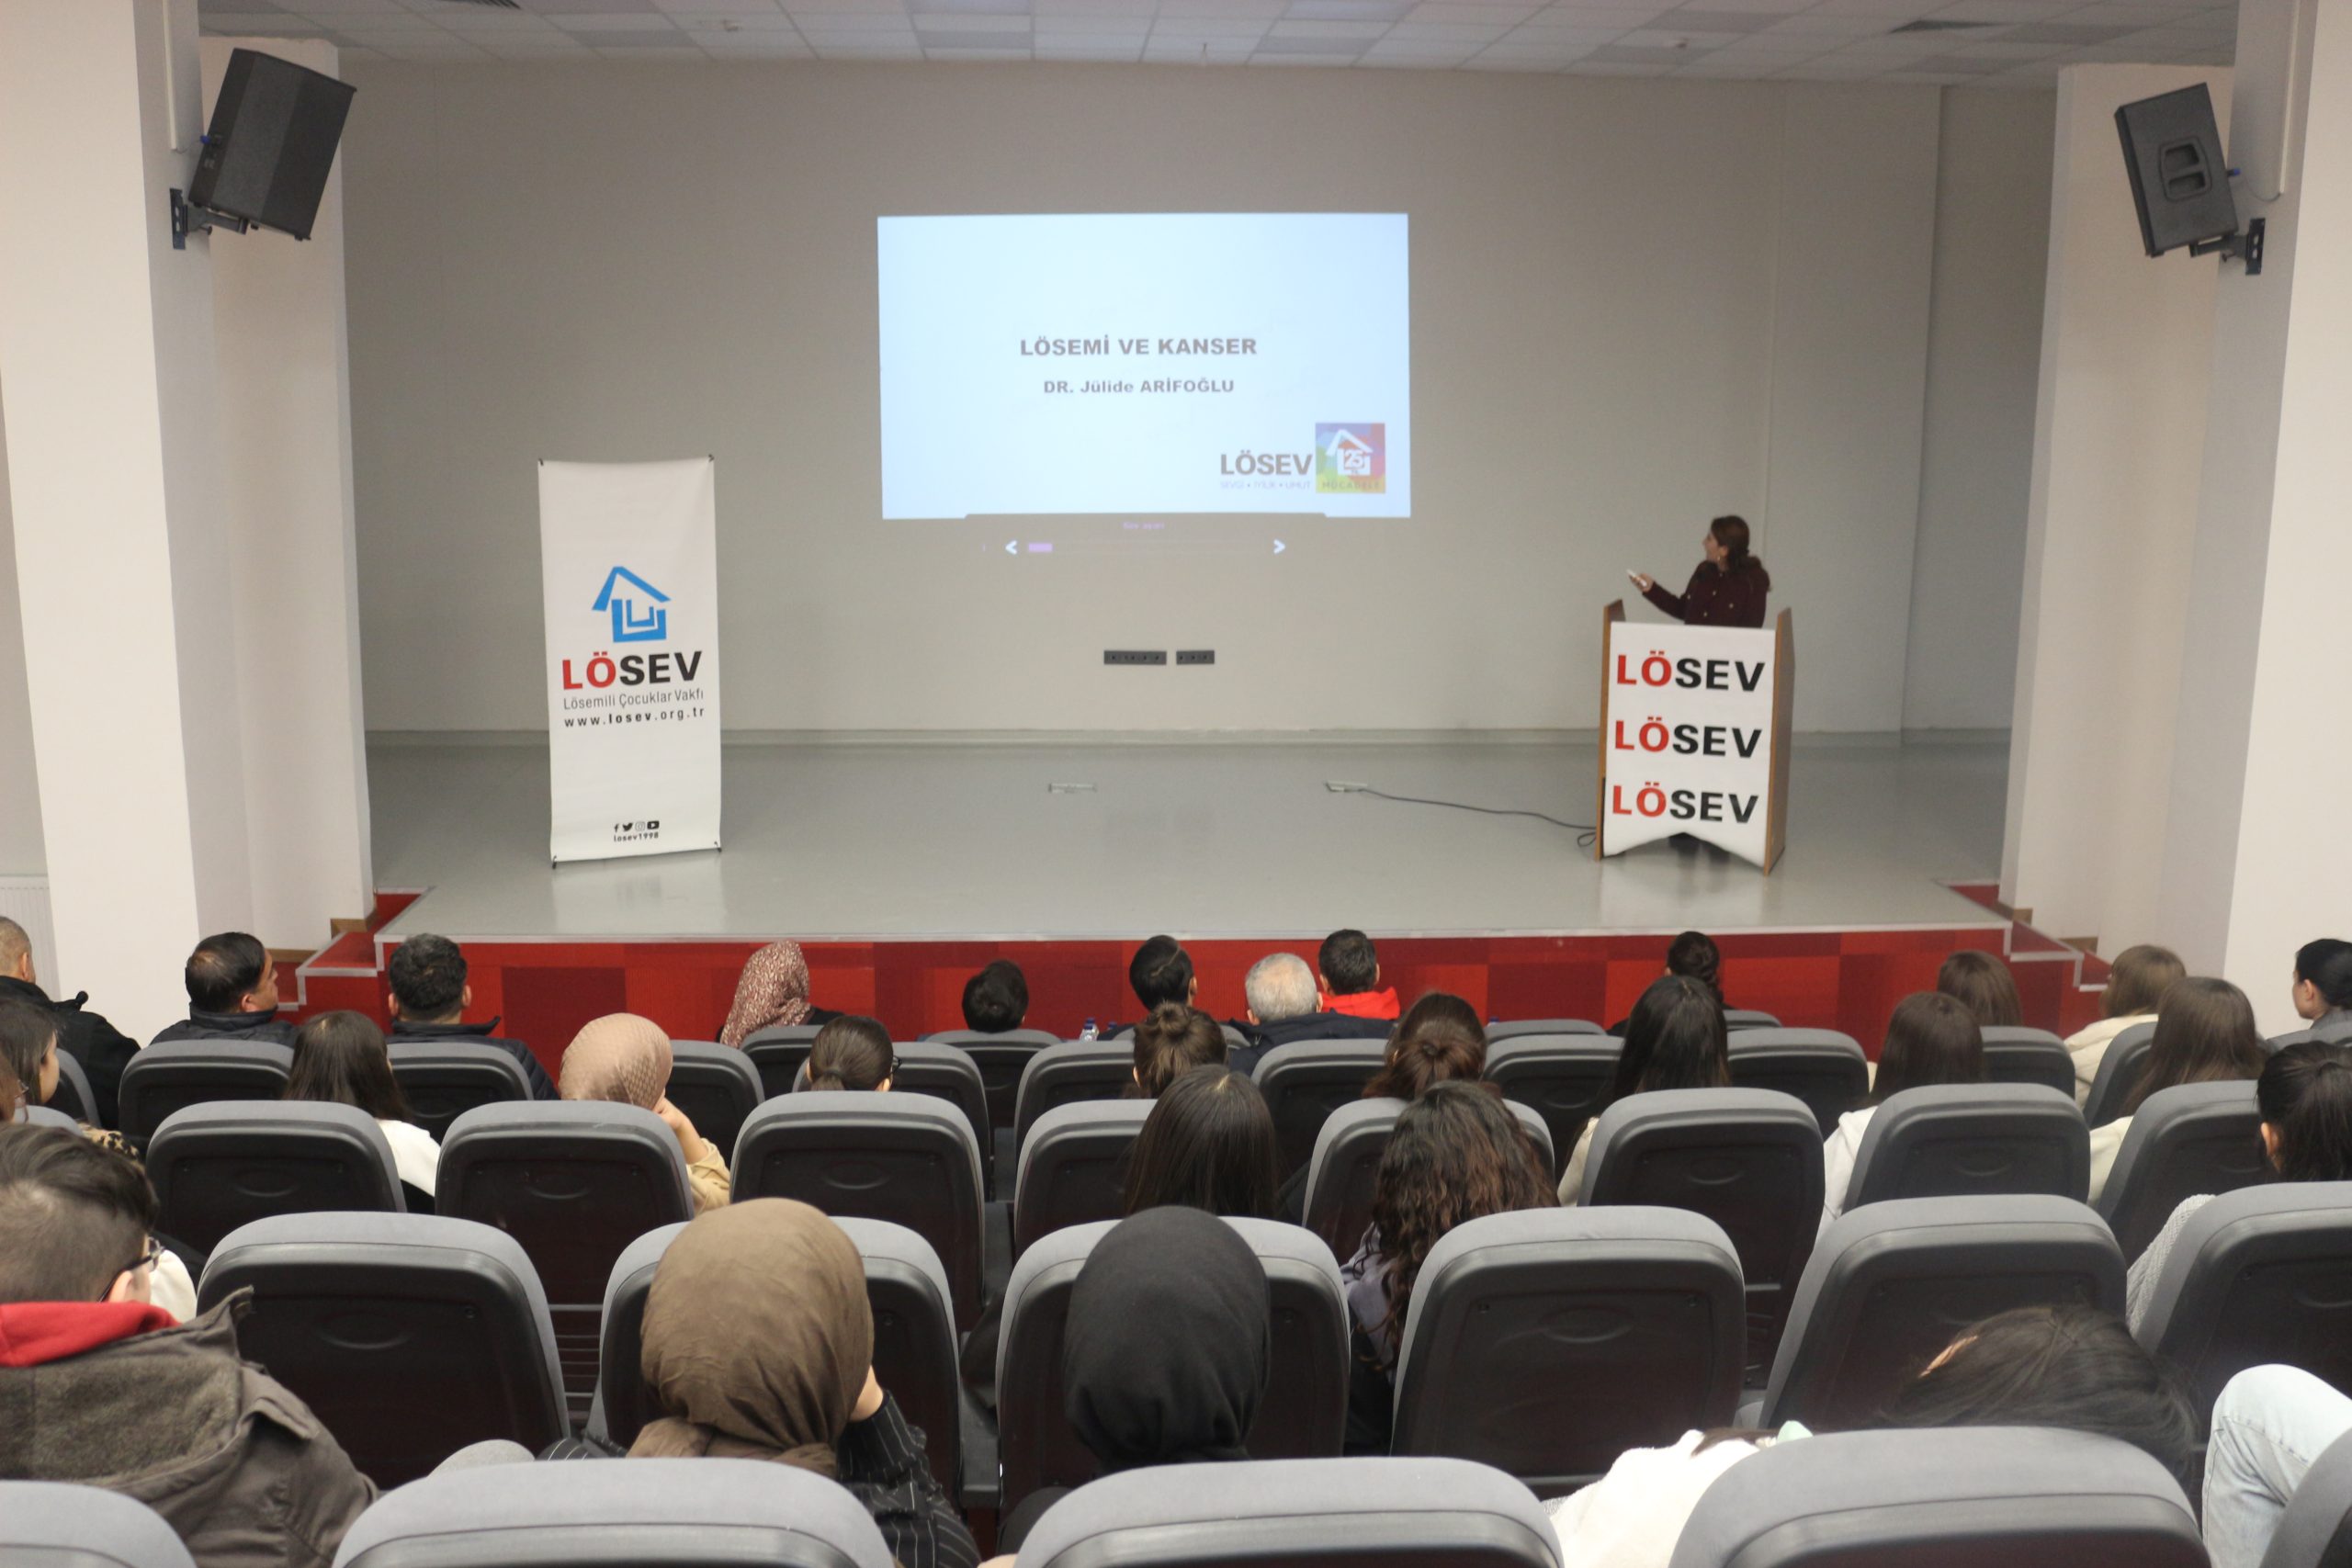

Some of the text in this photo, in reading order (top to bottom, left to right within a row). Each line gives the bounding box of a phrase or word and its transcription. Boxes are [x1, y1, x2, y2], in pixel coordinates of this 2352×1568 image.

[1020, 334, 1258, 356] LÖSEMİ VE KANSER
[1044, 377, 1235, 394] DR. Jülide ARİFOĞLU
[1219, 449, 1313, 476] LÖSEV
[561, 649, 703, 691] LÖSEV
[1616, 649, 1766, 693] LÖSEV
[563, 687, 704, 710] Lösemili Çocuklar Vakfı
[564, 706, 705, 728] www.losev.org.tr
[1614, 716, 1763, 759] LÖSEV
[1612, 782, 1759, 824] LÖSEV
